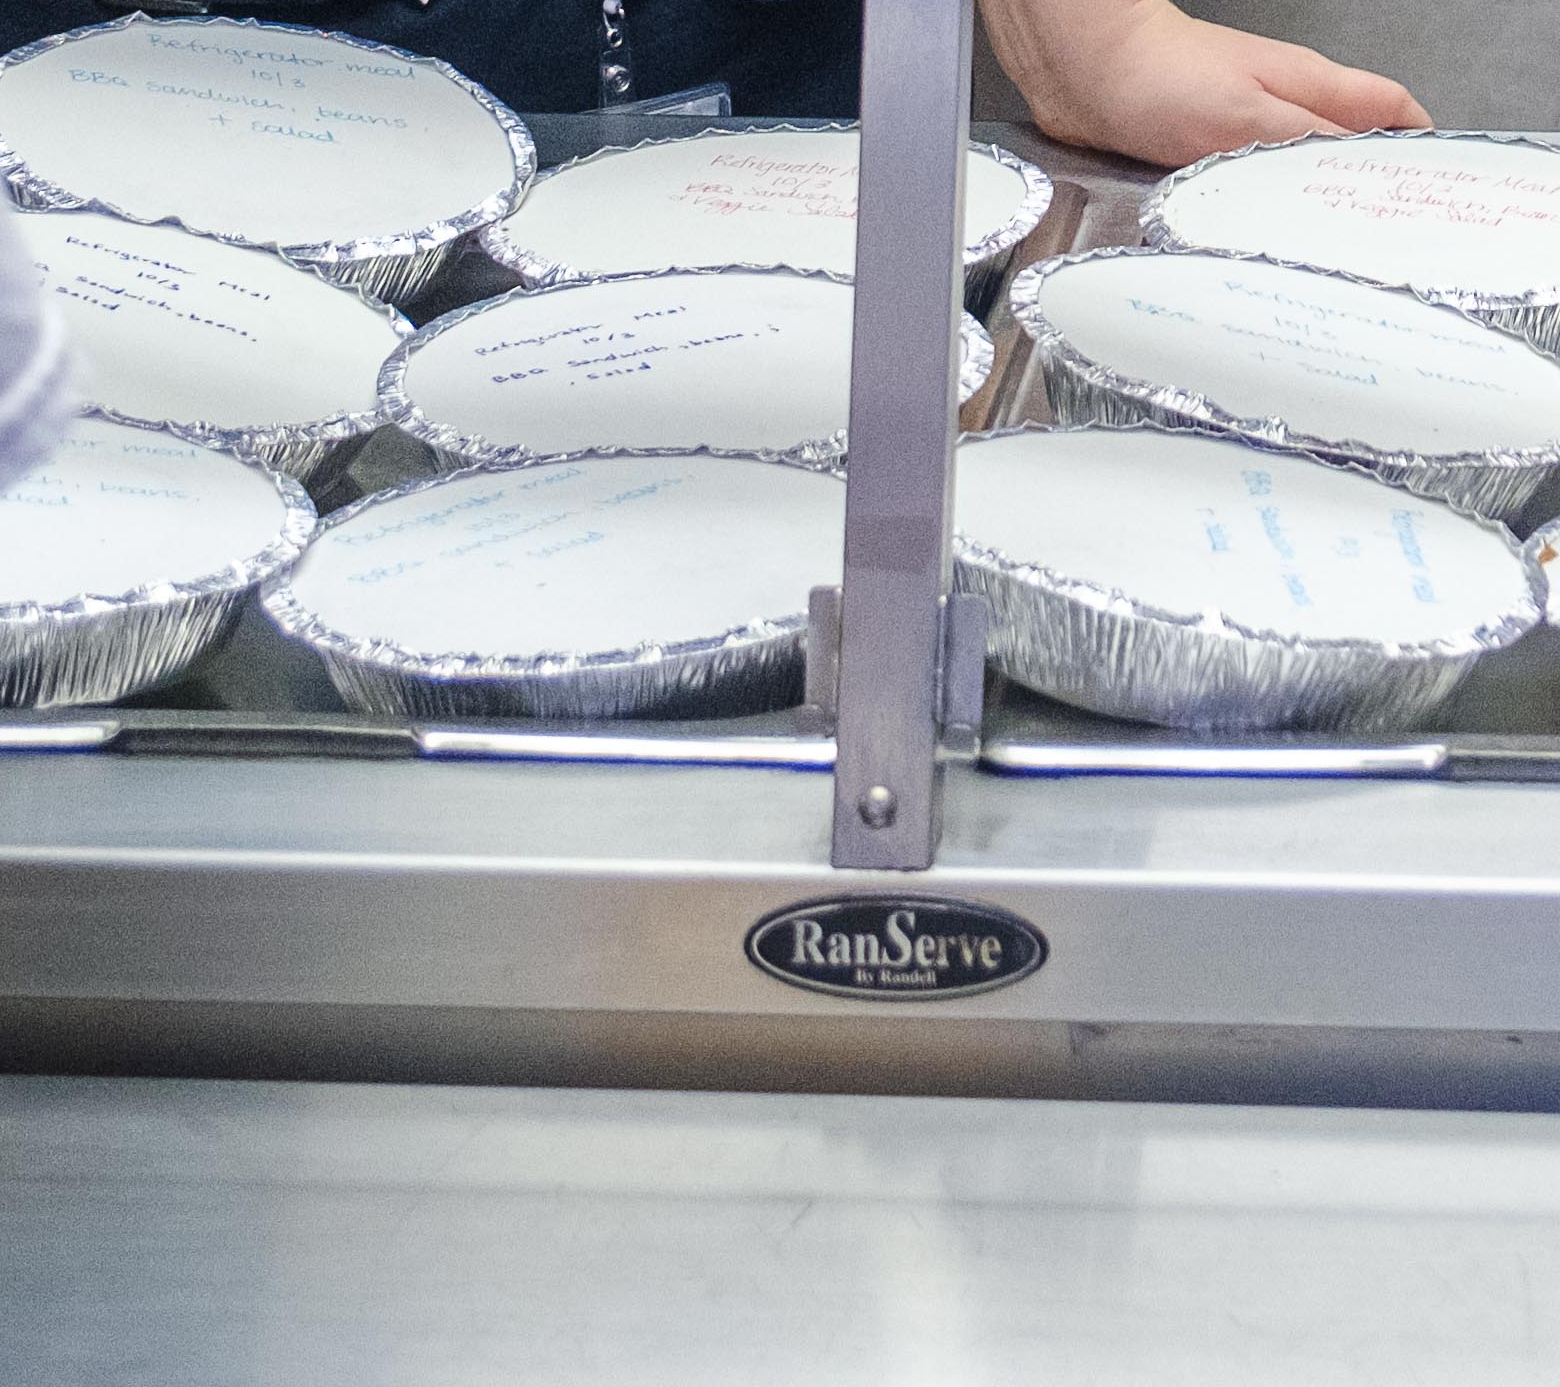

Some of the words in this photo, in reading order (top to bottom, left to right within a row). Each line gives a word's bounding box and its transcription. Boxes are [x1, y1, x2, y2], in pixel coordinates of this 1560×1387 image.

[150, 35, 328, 68] Refrigerator
[64, 234, 197, 277] Refrigerator
[474, 322, 604, 357] Refrigerator
[491, 366, 549, 385] BBQ
[792, 910, 1003, 970] RanServe
